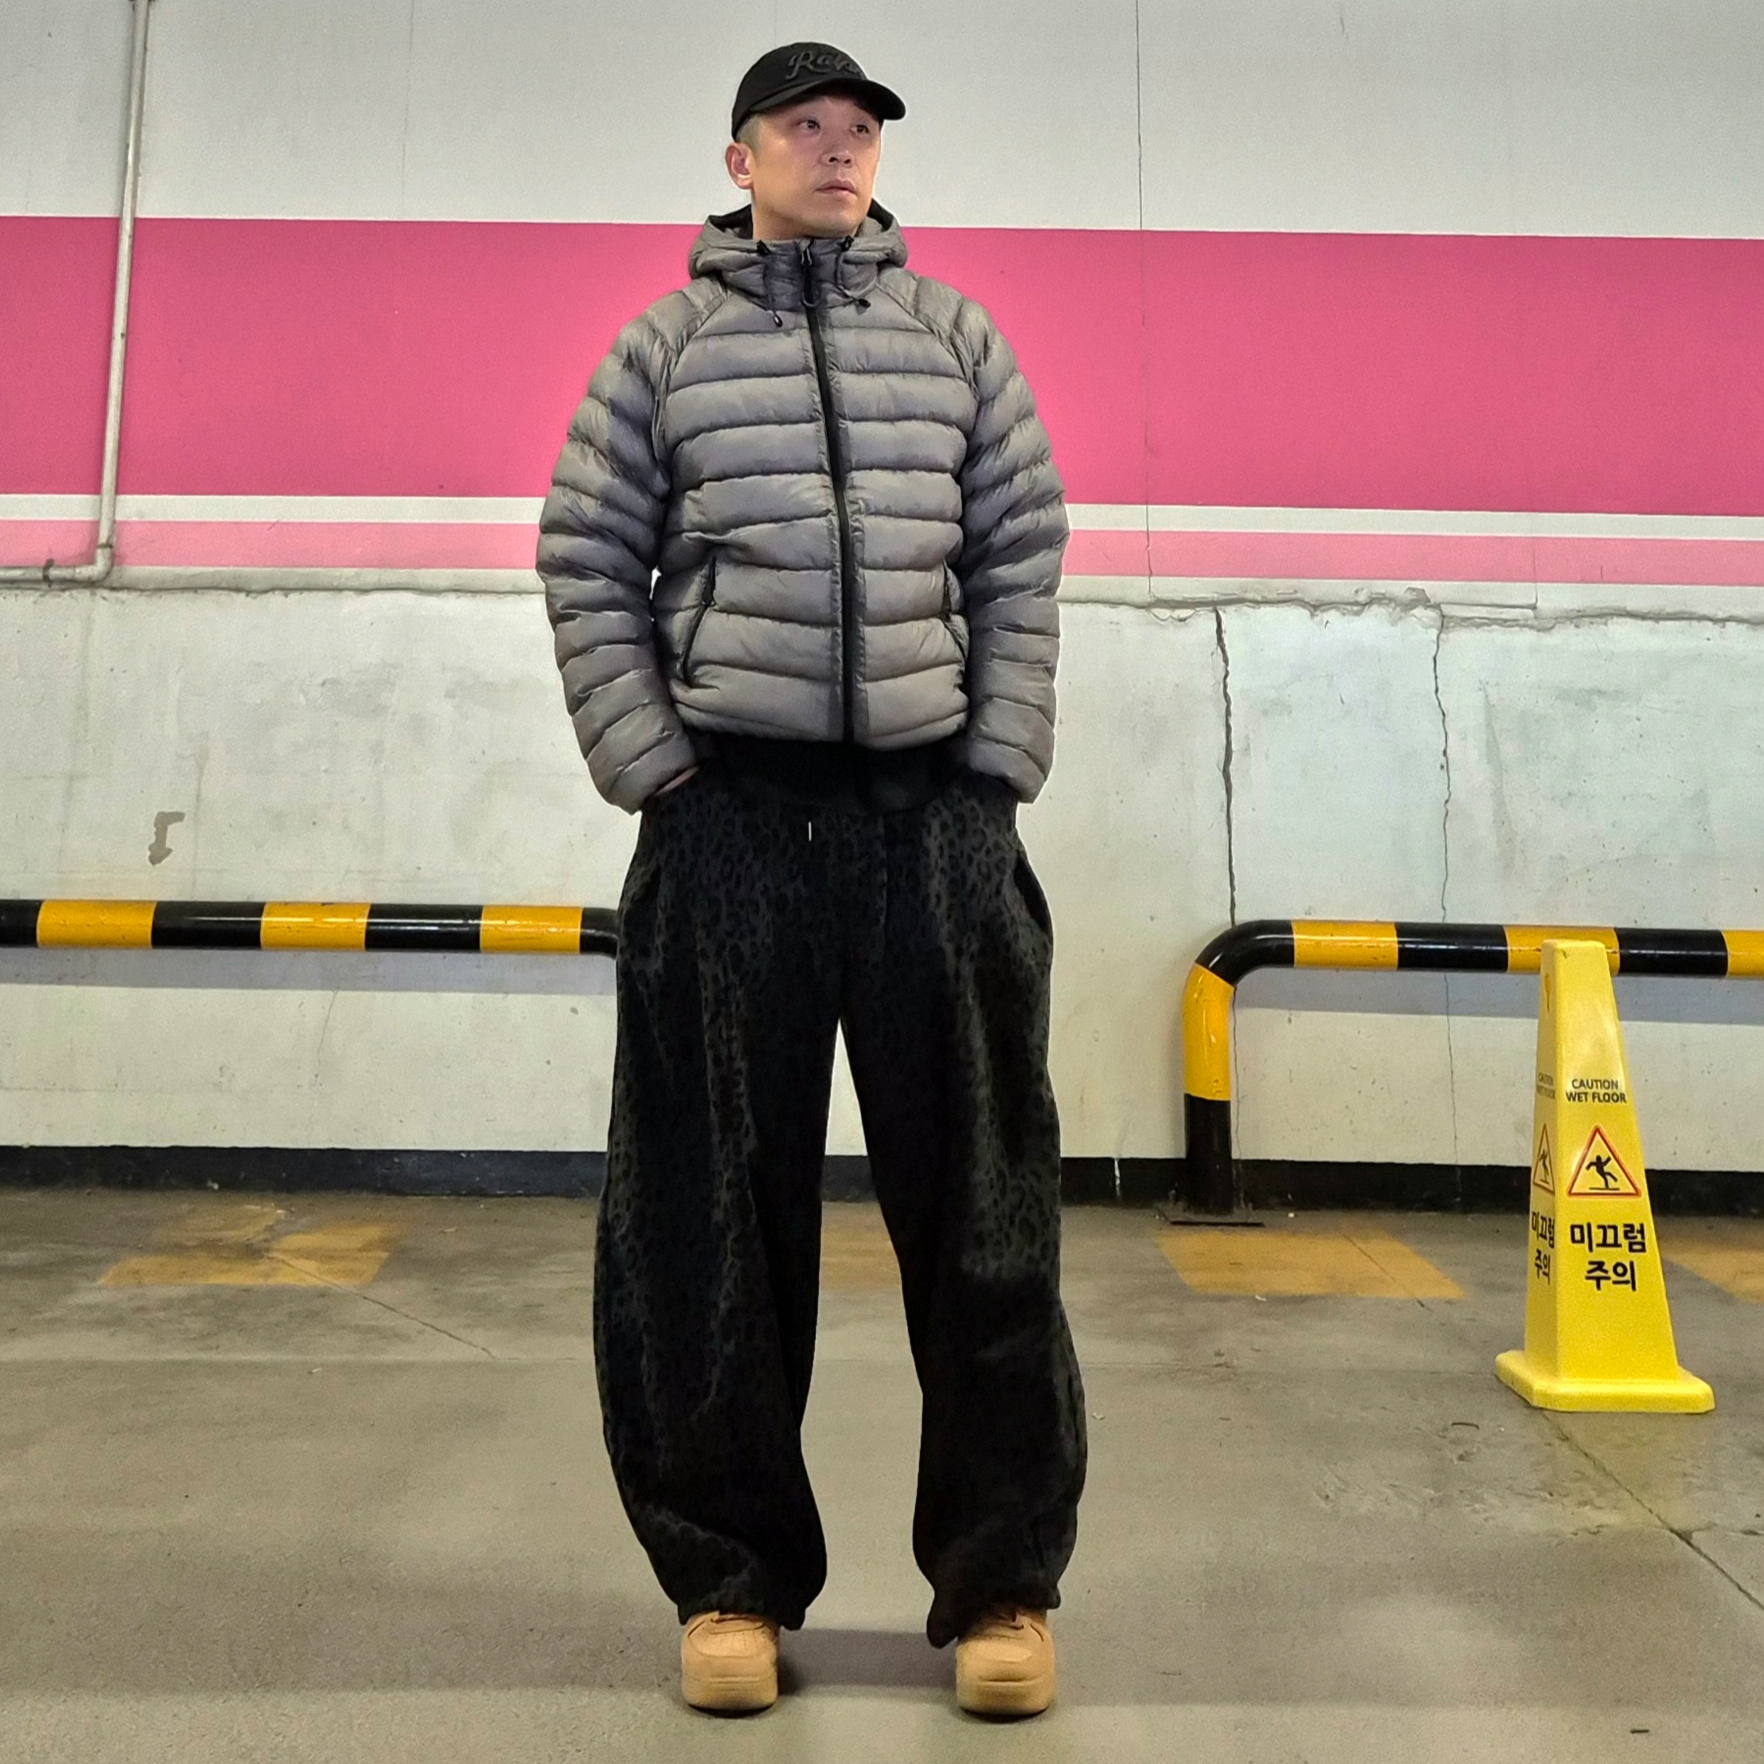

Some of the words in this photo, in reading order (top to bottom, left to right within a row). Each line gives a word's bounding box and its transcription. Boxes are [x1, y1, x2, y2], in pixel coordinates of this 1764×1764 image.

[1571, 1078, 1619, 1090] CAUTION
[1565, 1091, 1589, 1102] WET
[1592, 1091, 1627, 1103] FLOOR
[1569, 1222, 1646, 1253] 미끄럼
[1584, 1260, 1637, 1291] 주의
